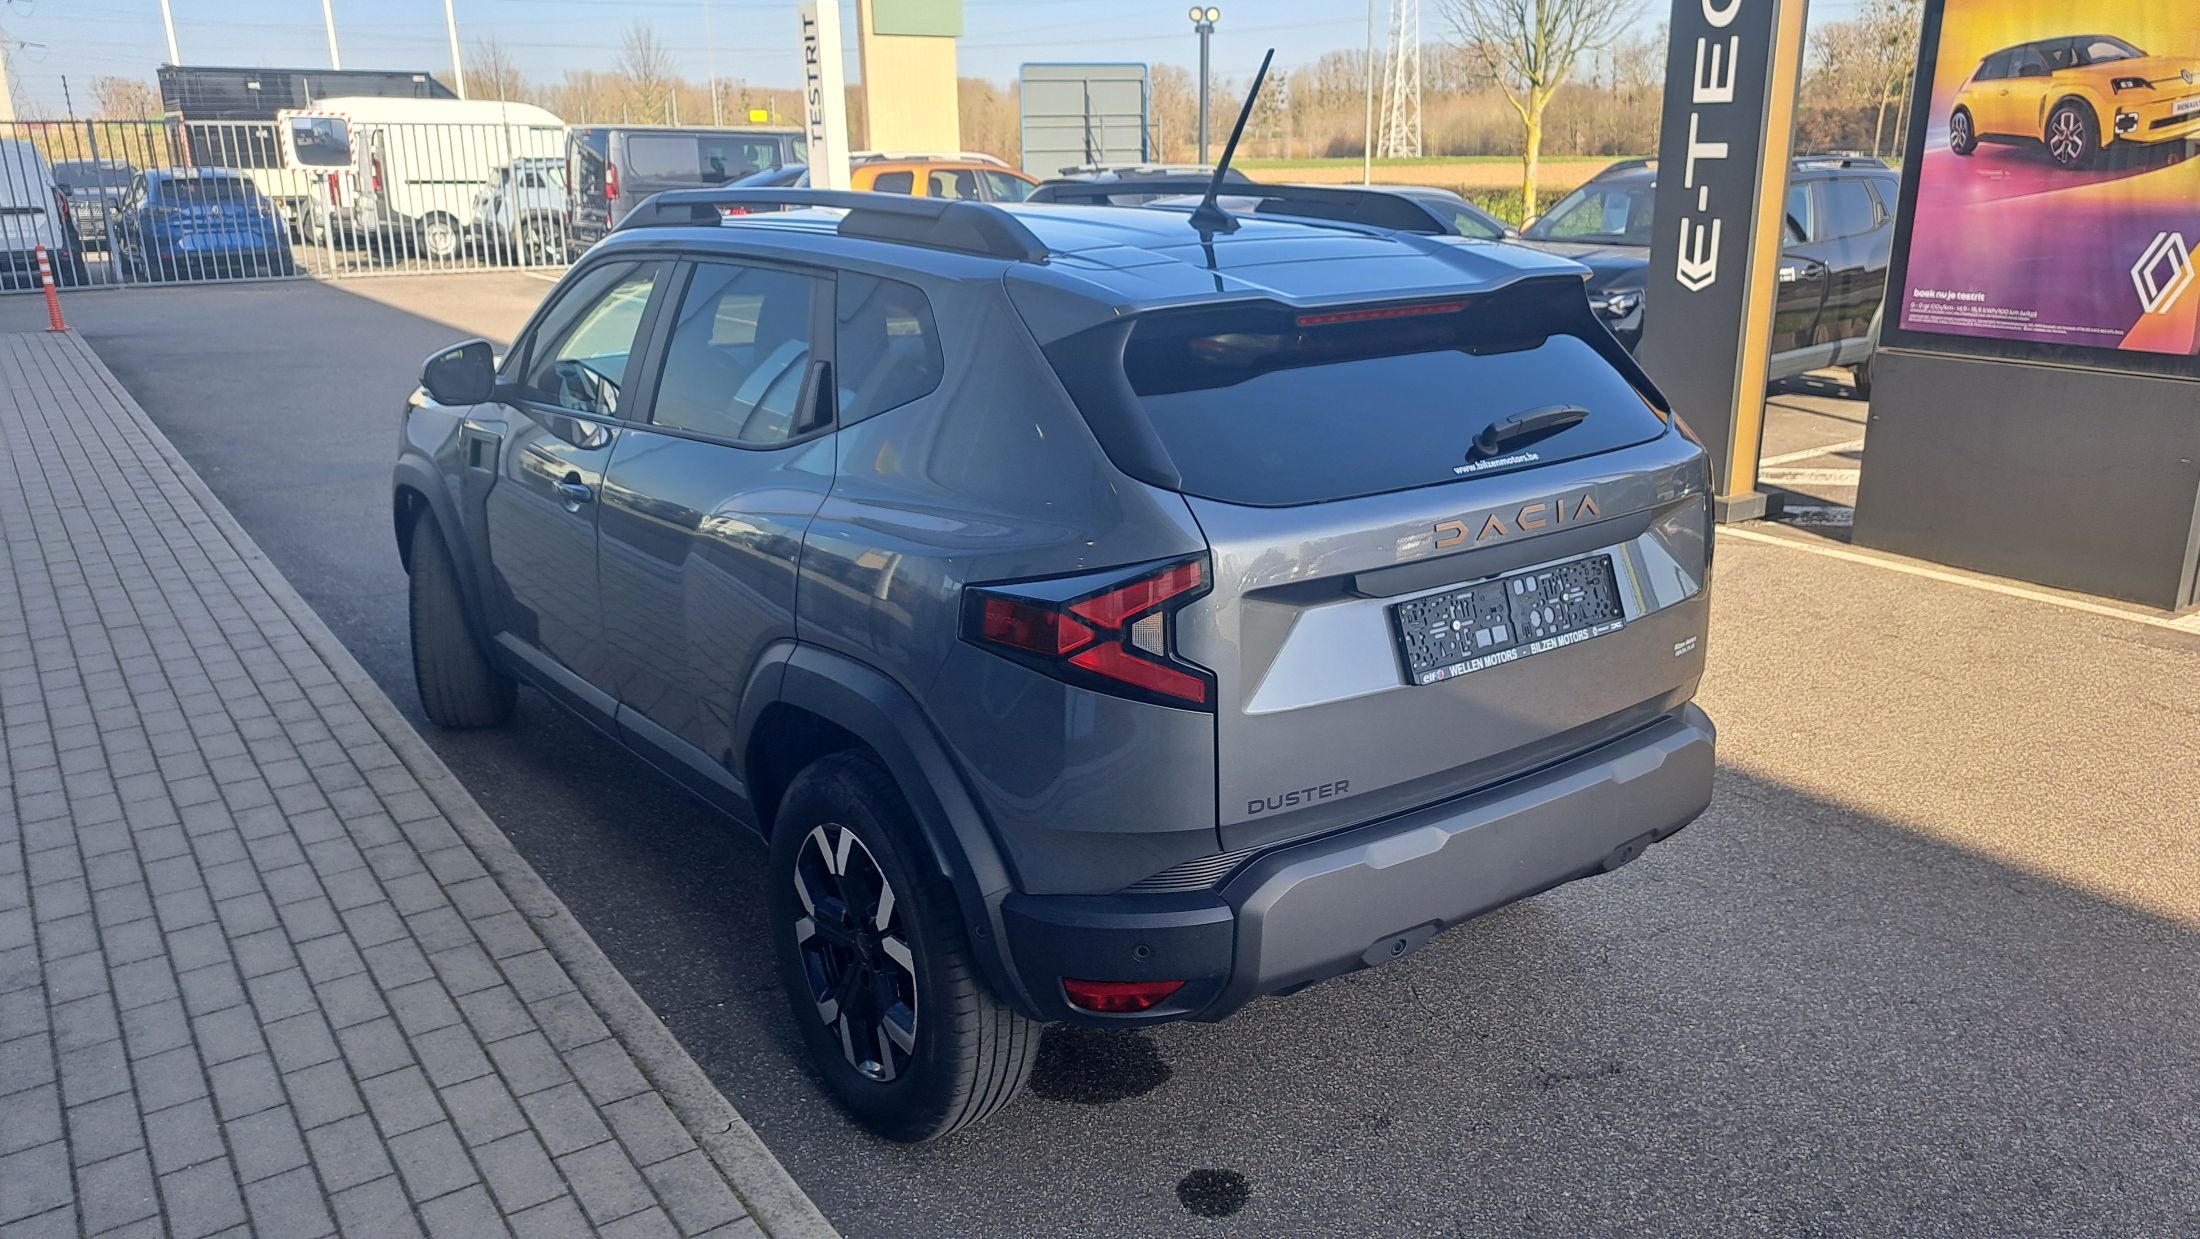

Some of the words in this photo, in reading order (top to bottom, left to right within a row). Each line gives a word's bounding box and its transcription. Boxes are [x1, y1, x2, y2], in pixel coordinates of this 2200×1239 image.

[803, 13, 823, 148] TESTRIT
[1936, 291, 1946, 299] nu
[1946, 290, 1956, 301] je
[1957, 291, 1985, 302] testrit
[1454, 452, 1539, 475] www.bilzenmotors.be
[1434, 494, 1601, 549] DACIA
[1423, 671, 1437, 683] elf
[1449, 659, 1484, 677] WELLEN
[1484, 649, 1518, 668] MOTORS
[1530, 637, 1558, 654] BILZEN
[1558, 629, 1589, 647] MOTORS
[1248, 780, 1349, 815] DUSTER
